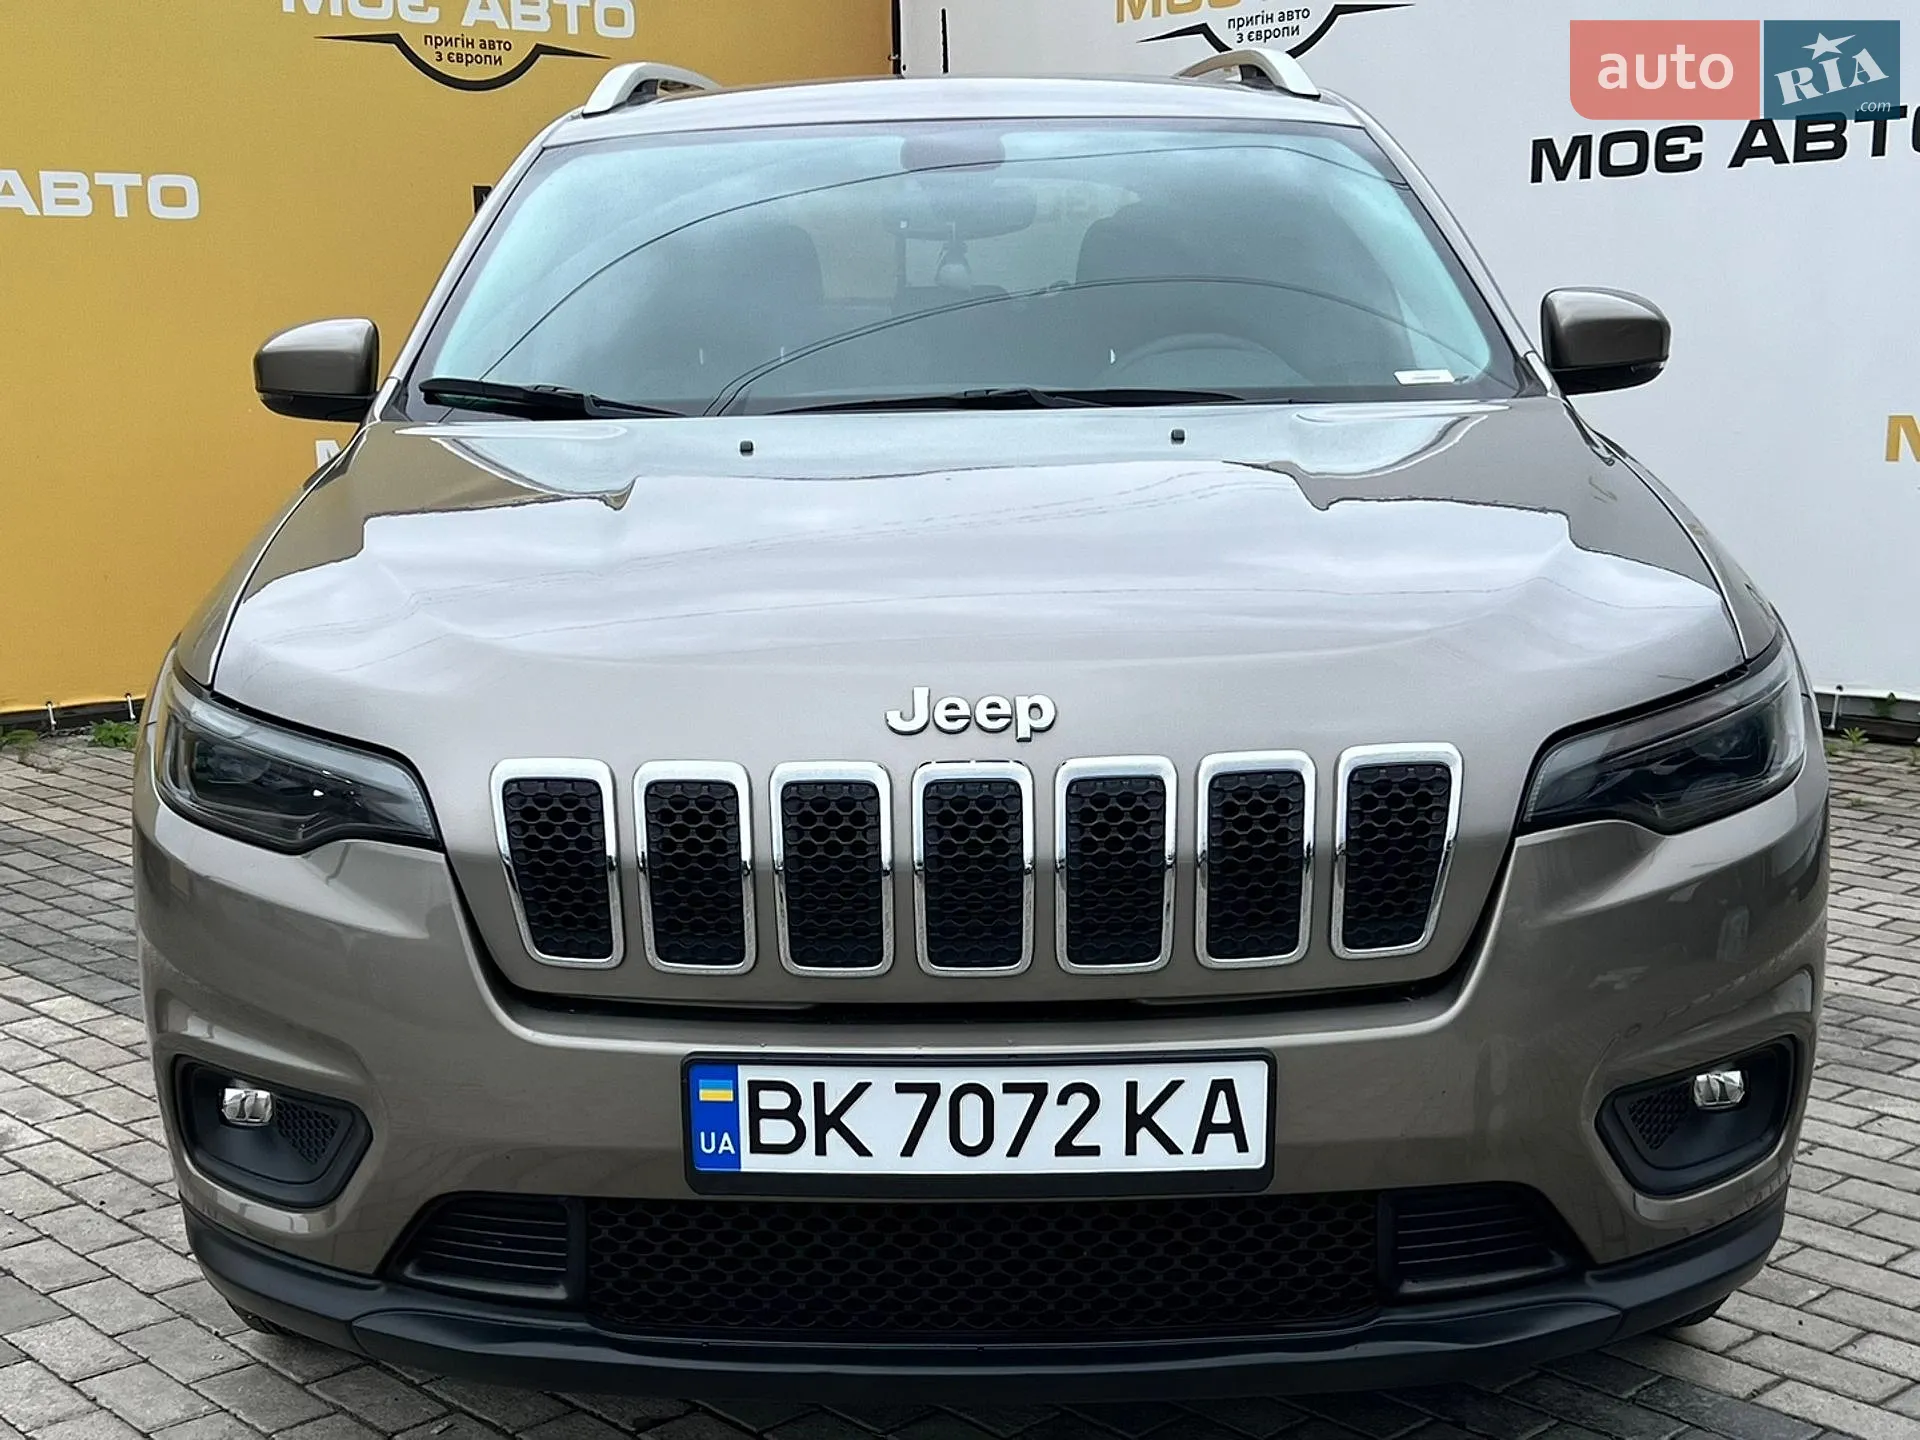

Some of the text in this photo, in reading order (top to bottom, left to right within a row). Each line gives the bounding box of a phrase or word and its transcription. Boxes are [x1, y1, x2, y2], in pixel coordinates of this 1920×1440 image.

[461, 0, 635, 38] АВТО
[1228, 10, 1274, 31] пригін
[1278, 8, 1310, 22] авто
[1237, 25, 1300, 43] з європи
[424, 33, 512, 51] пригін авто
[435, 51, 502, 67] з європи
[1530, 104, 1920, 184] МОЄ АВТ
[0, 169, 200, 219] АВТО
[886, 686, 1057, 742] Jeep
[747, 1078, 1251, 1158] BK 7072 KA
[700, 1132, 735, 1155] UA
